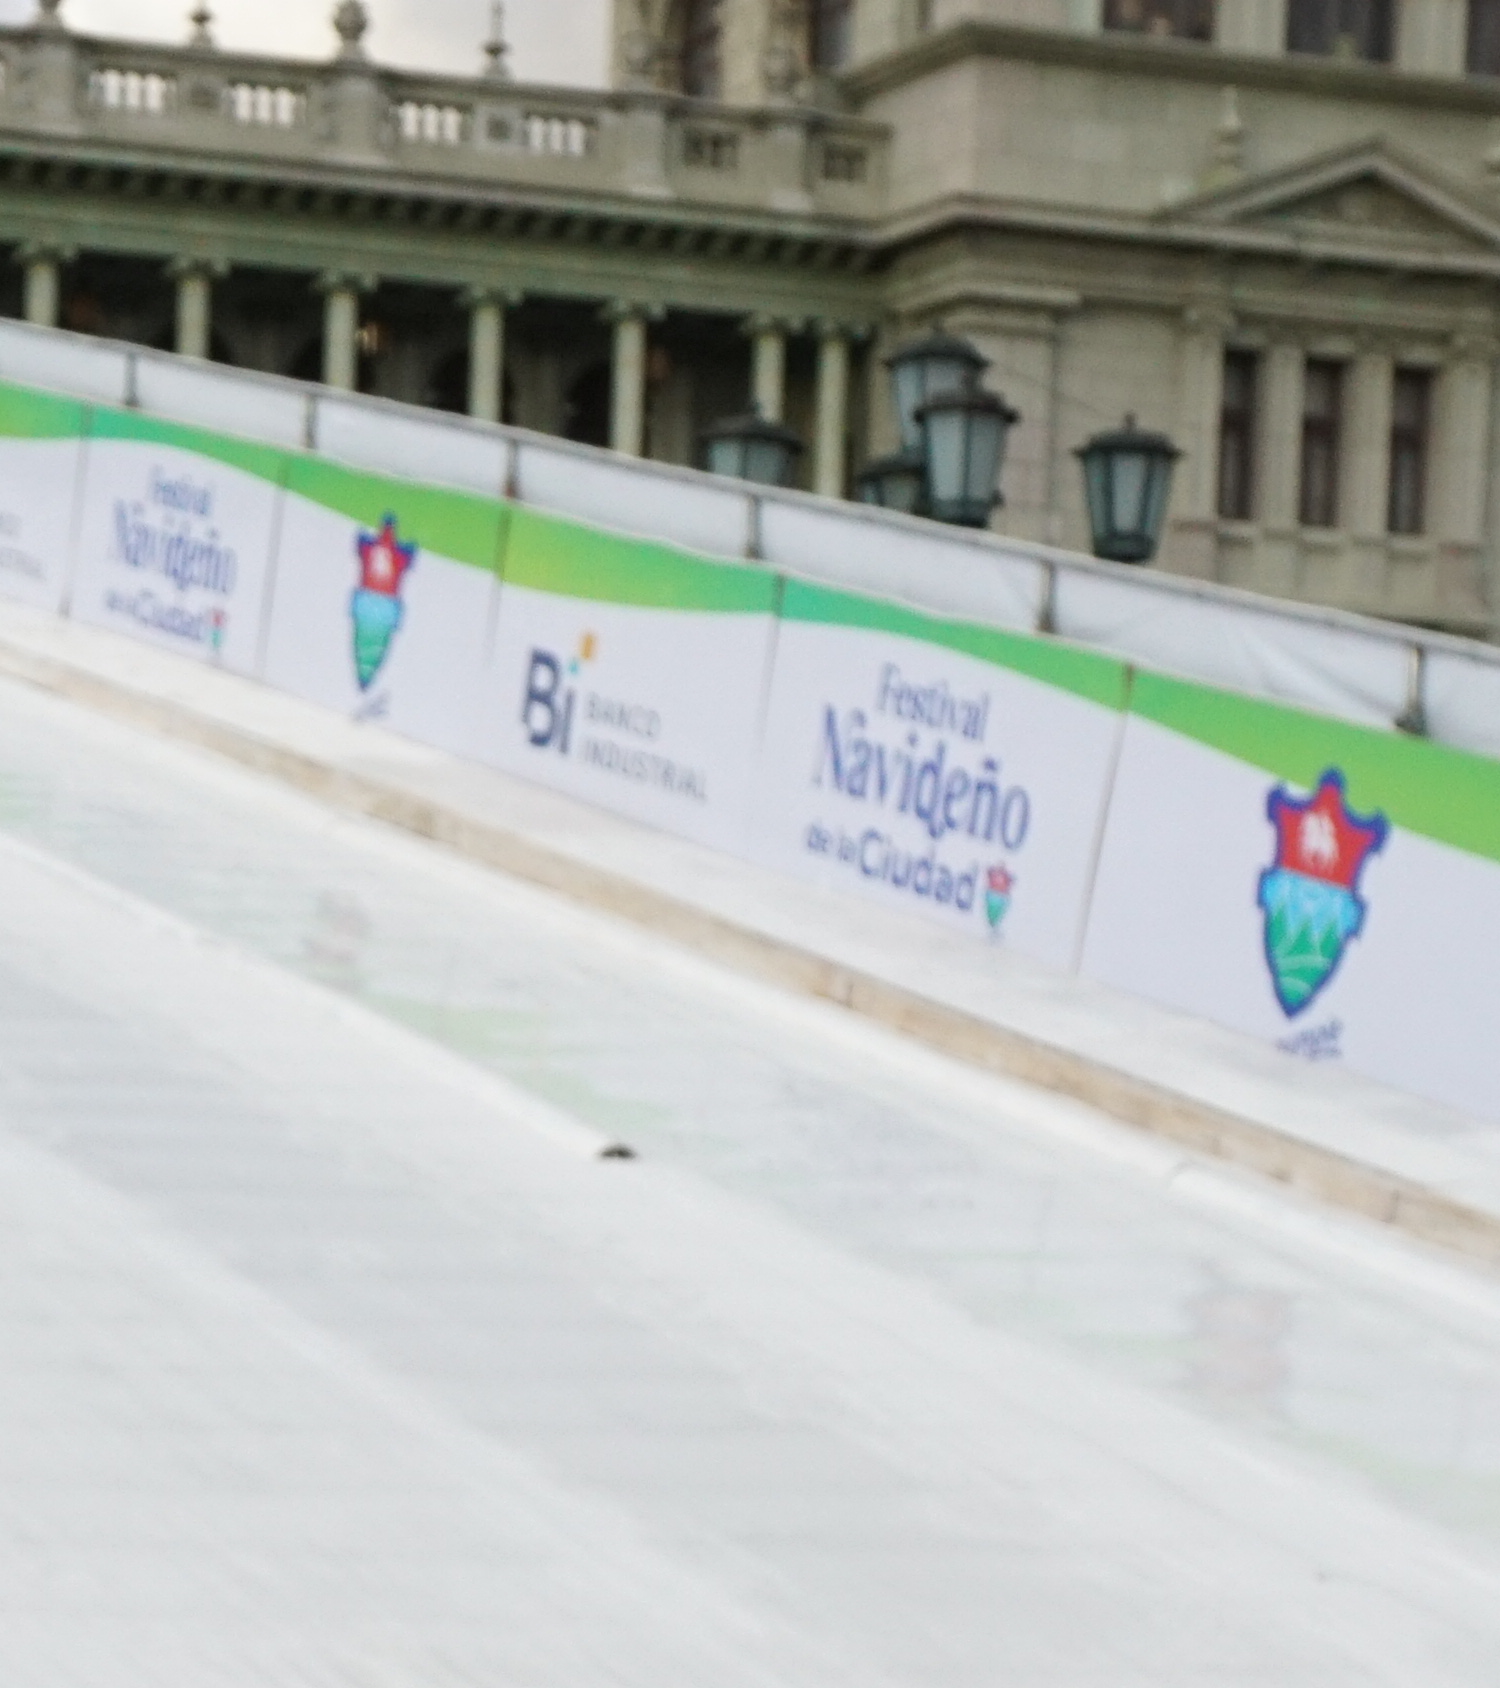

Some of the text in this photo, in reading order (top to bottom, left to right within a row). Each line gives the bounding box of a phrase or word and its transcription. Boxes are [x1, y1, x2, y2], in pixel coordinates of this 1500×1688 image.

[520, 645, 582, 756] Bi
[583, 696, 662, 742] BANCO
[877, 662, 991, 742] Festival
[582, 741, 708, 800] INDUSTRIAL
[813, 703, 1031, 852] Navideño
[857, 828, 980, 912] Ciudad
